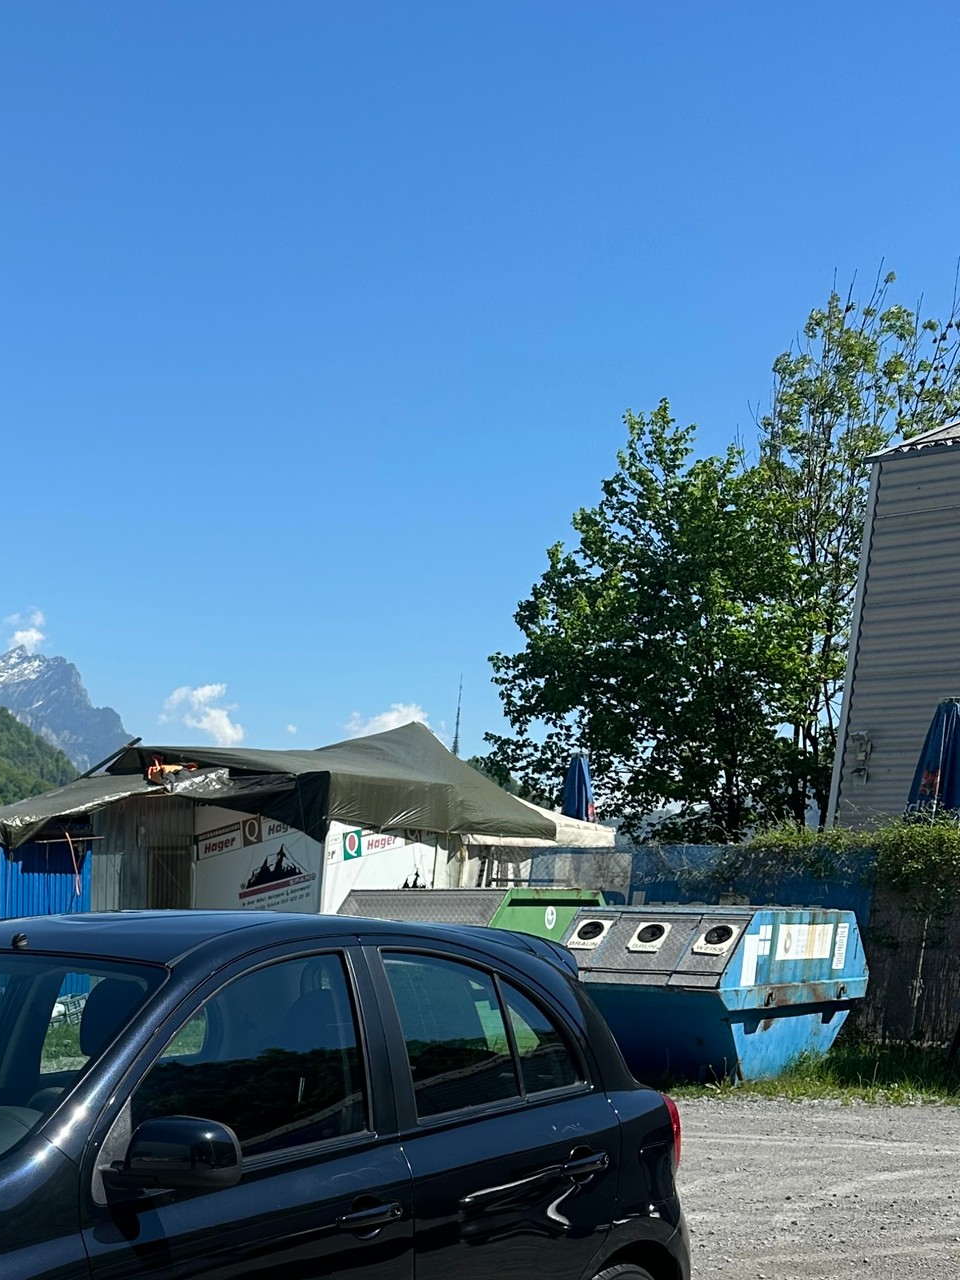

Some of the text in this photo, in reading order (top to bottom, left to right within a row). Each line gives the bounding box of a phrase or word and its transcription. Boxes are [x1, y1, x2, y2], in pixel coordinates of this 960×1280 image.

[267, 822, 293, 836] Hag
[203, 836, 236, 854] Hager
[366, 836, 397, 851] Hager
